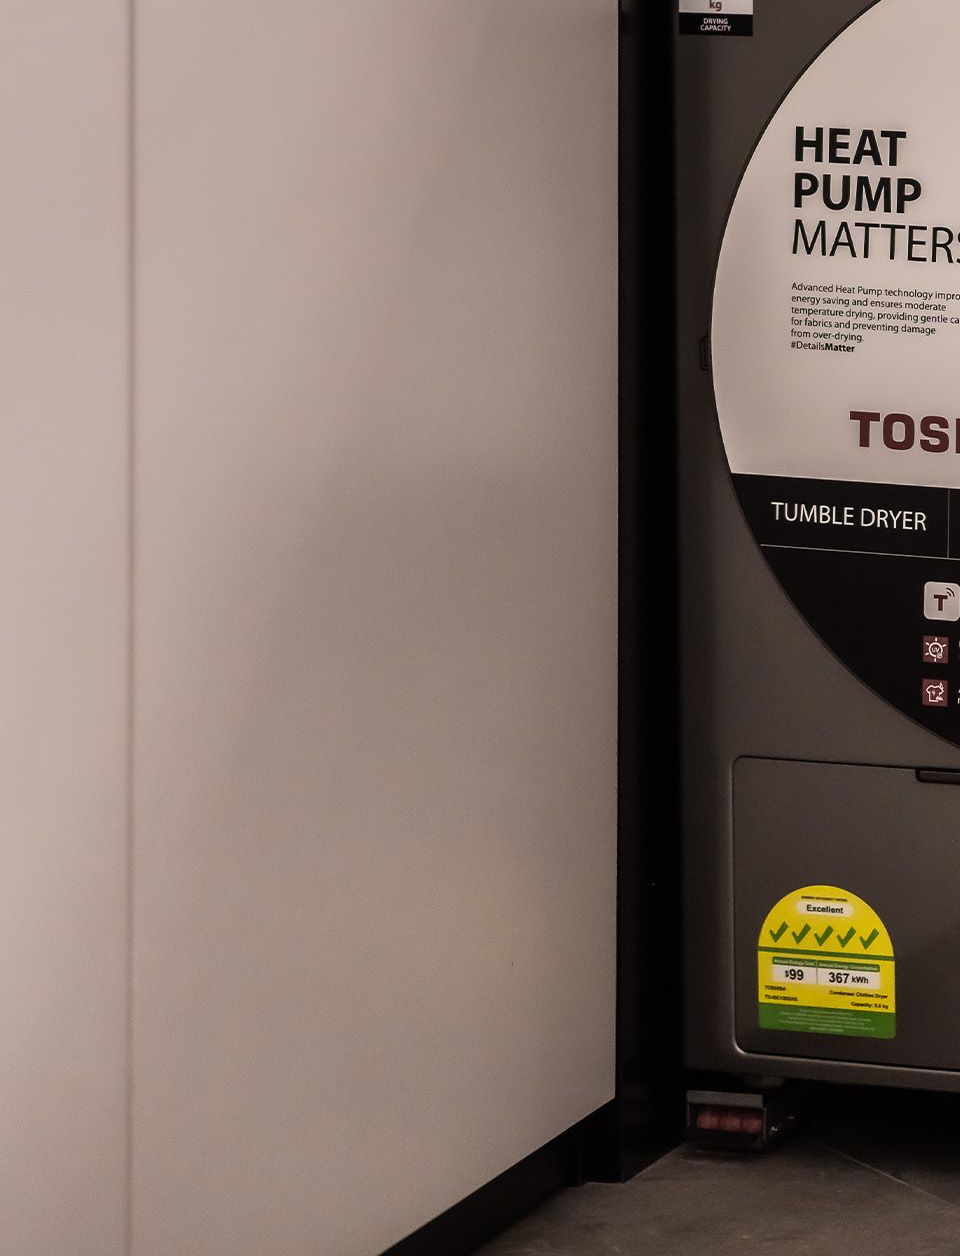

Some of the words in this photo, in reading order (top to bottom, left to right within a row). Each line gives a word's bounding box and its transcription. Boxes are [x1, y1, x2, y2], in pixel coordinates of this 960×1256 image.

[709, 0, 722, 12] kg
[700, 24, 731, 32] CAPACITY
[794, 126, 907, 167] HEAT
[793, 172, 922, 214] PUMP
[791, 282, 833, 293] Advanced
[836, 285, 855, 294] Heat
[857, 286, 883, 297] Pump
[884, 288, 933, 300] technology
[791, 296, 820, 305] energy
[822, 297, 850, 307] saving
[852, 298, 868, 307] and
[870, 300, 903, 308] ensures
[904, 302, 947, 311] moderate
[791, 307, 844, 316] temperature
[846, 309, 876, 321] drying,
[877, 312, 919, 324] providing
[920, 314, 948, 324] gentle
[791, 317, 802, 326] for
[804, 317, 833, 328] fabrics
[834, 320, 851, 329] and
[852, 322, 899, 334] preventing
[901, 324, 936, 336] damage
[791, 328, 811, 338] from
[791, 341, 855, 353] #DetailsMatter
[771, 501, 854, 527] TUMBLE
[860, 508, 927, 531] DRYER
[806, 904, 844, 915] Excellent
[785, 969, 804, 981] $99
[829, 972, 849, 983] 367
[851, 975, 869, 984] kWh
